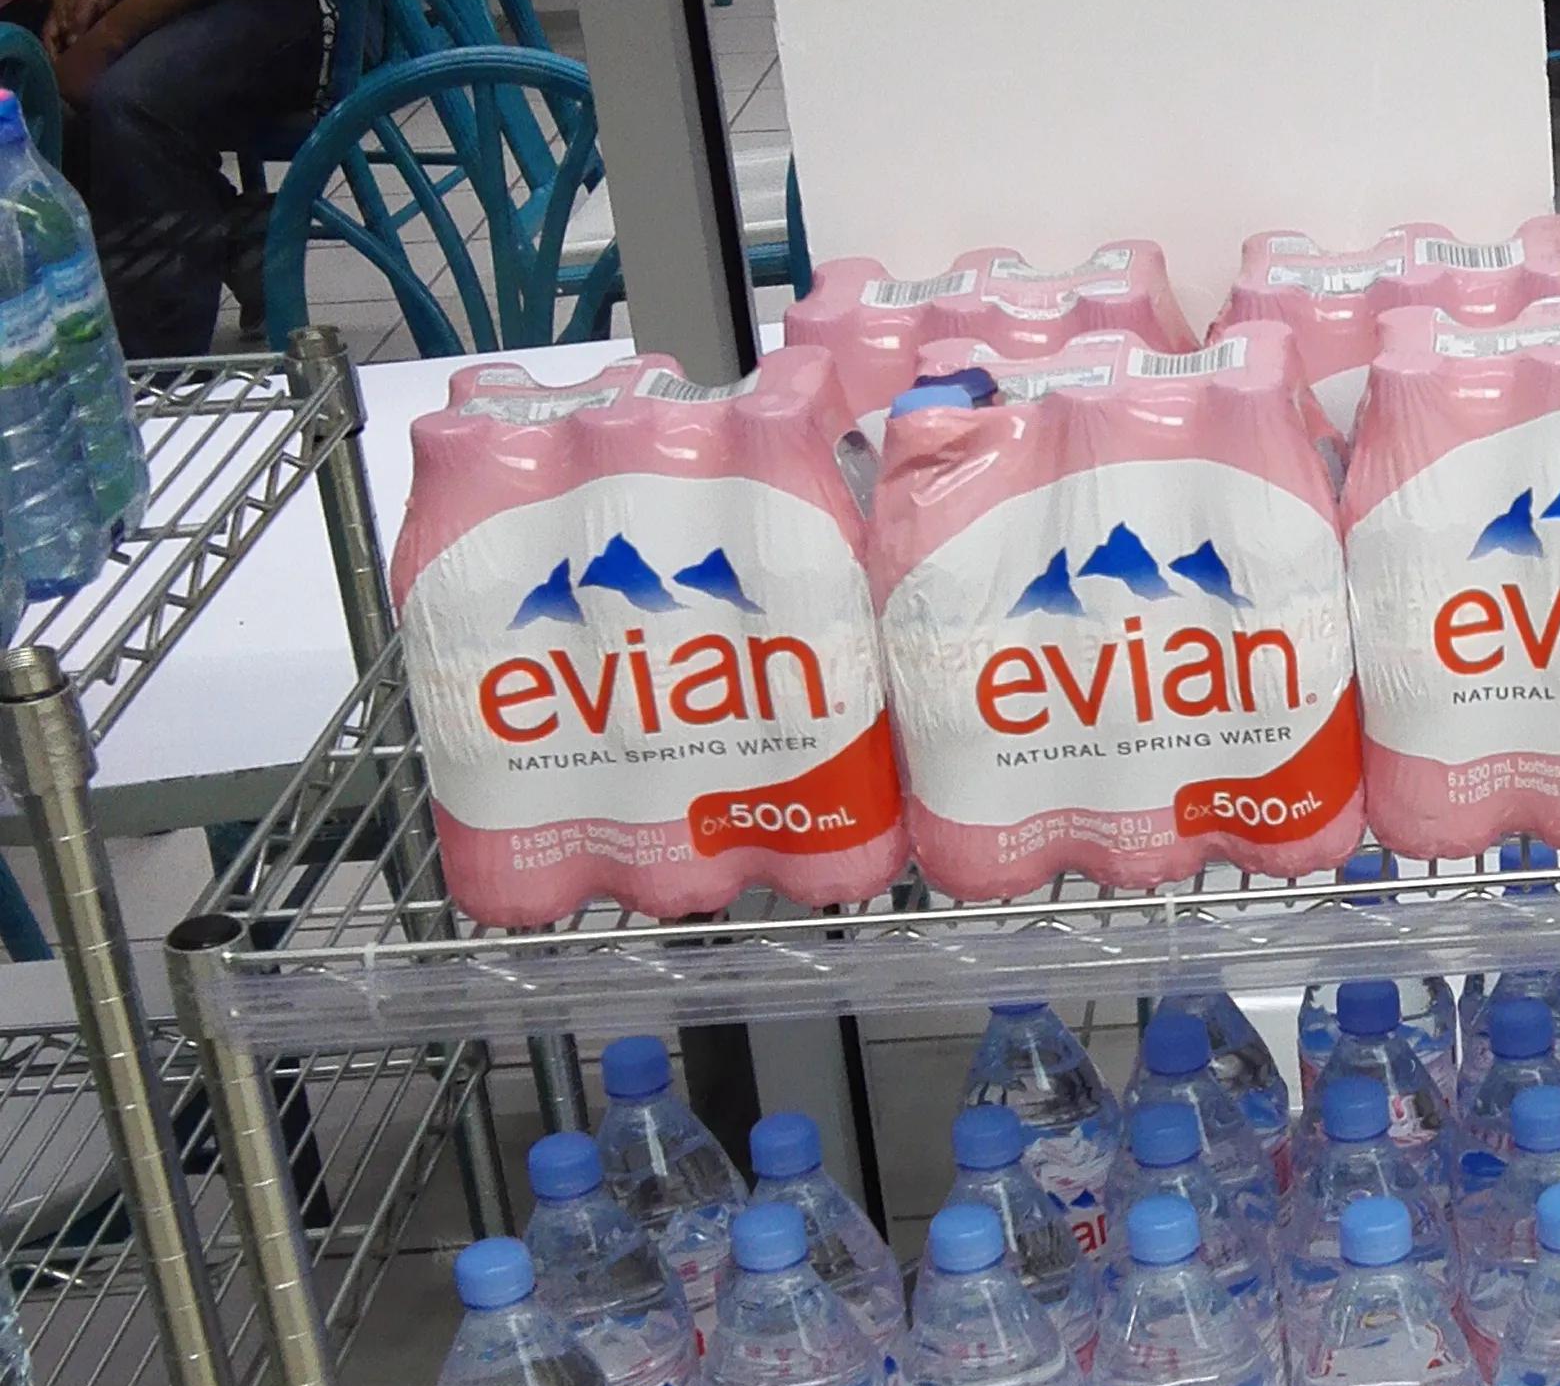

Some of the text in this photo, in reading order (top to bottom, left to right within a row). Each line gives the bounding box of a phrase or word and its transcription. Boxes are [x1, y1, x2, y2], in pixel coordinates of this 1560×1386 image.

[478, 626, 827, 743] evian
[976, 617, 1306, 735] evian
[1453, 686, 1555, 705] NATURAL
[508, 737, 818, 772] NATURAL SPRING WATER
[997, 726, 1292, 767] NATURAL SPRING WATER
